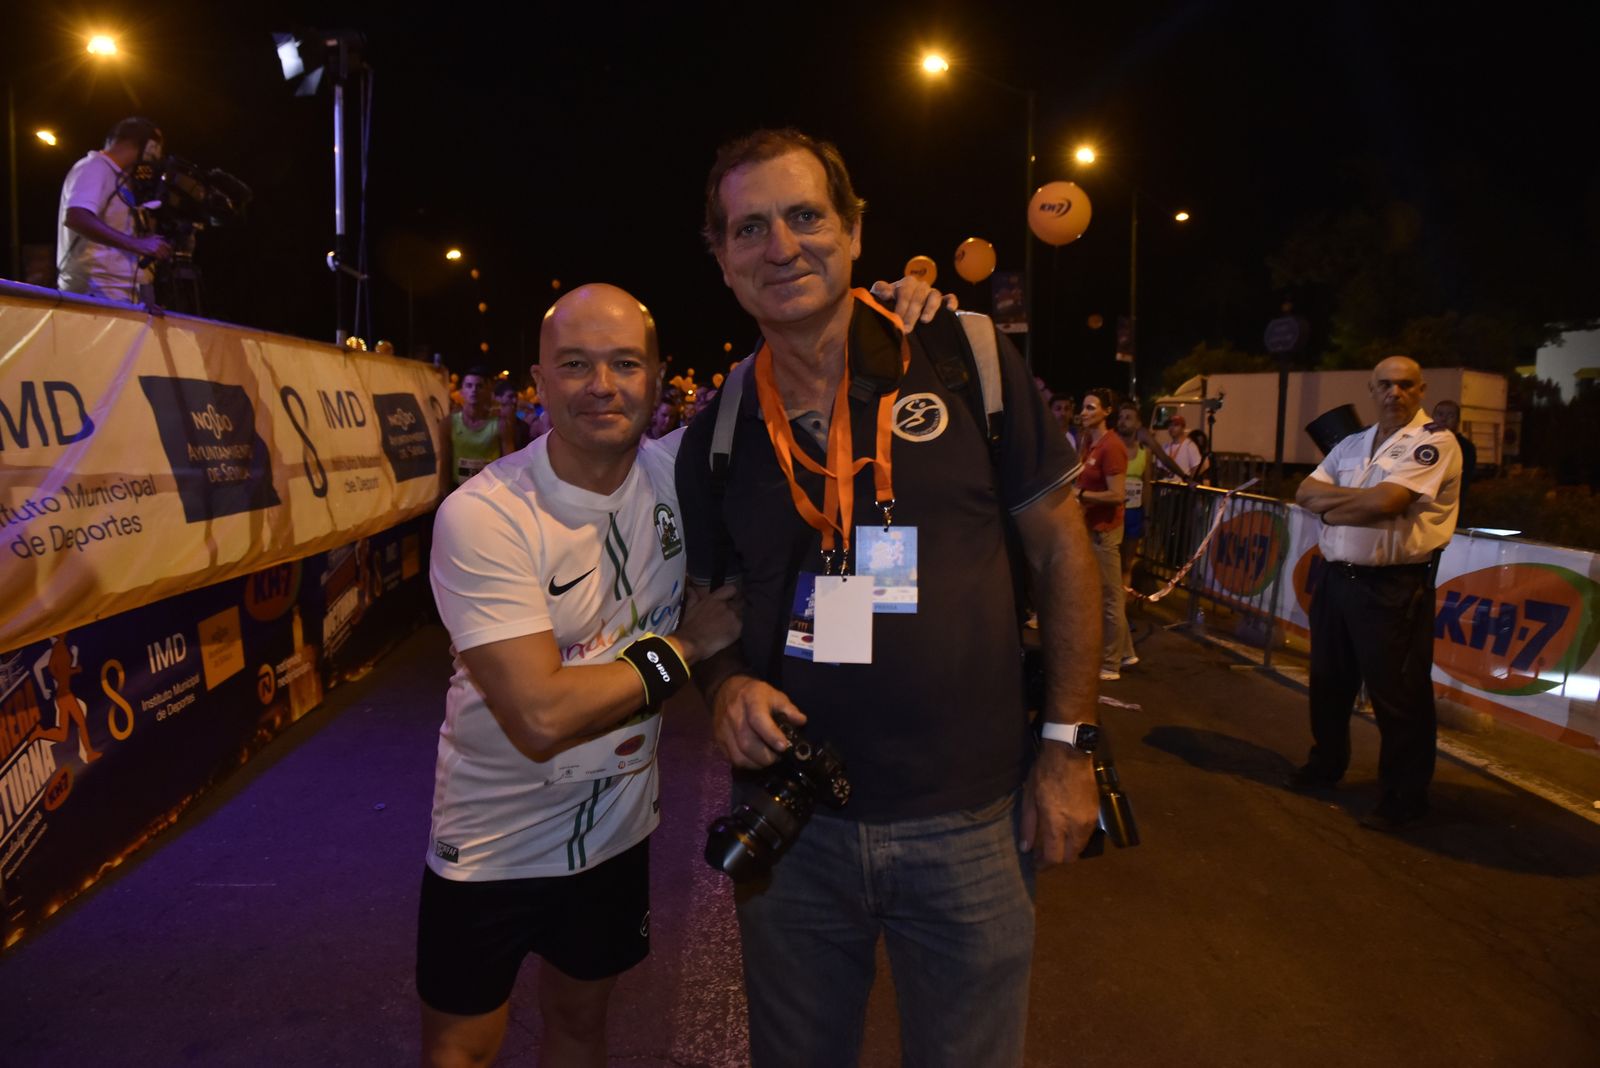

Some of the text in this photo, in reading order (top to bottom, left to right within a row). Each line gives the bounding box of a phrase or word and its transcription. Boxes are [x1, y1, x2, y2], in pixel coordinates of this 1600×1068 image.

[317, 390, 366, 429] IMD
[61, 474, 157, 509] Municipal
[10, 515, 142, 558] de Deportes
[1434, 591, 1571, 672] KH-7
[147, 632, 187, 674] IMD
[155, 709, 168, 722] de
[0, 737, 58, 842] TURNA
